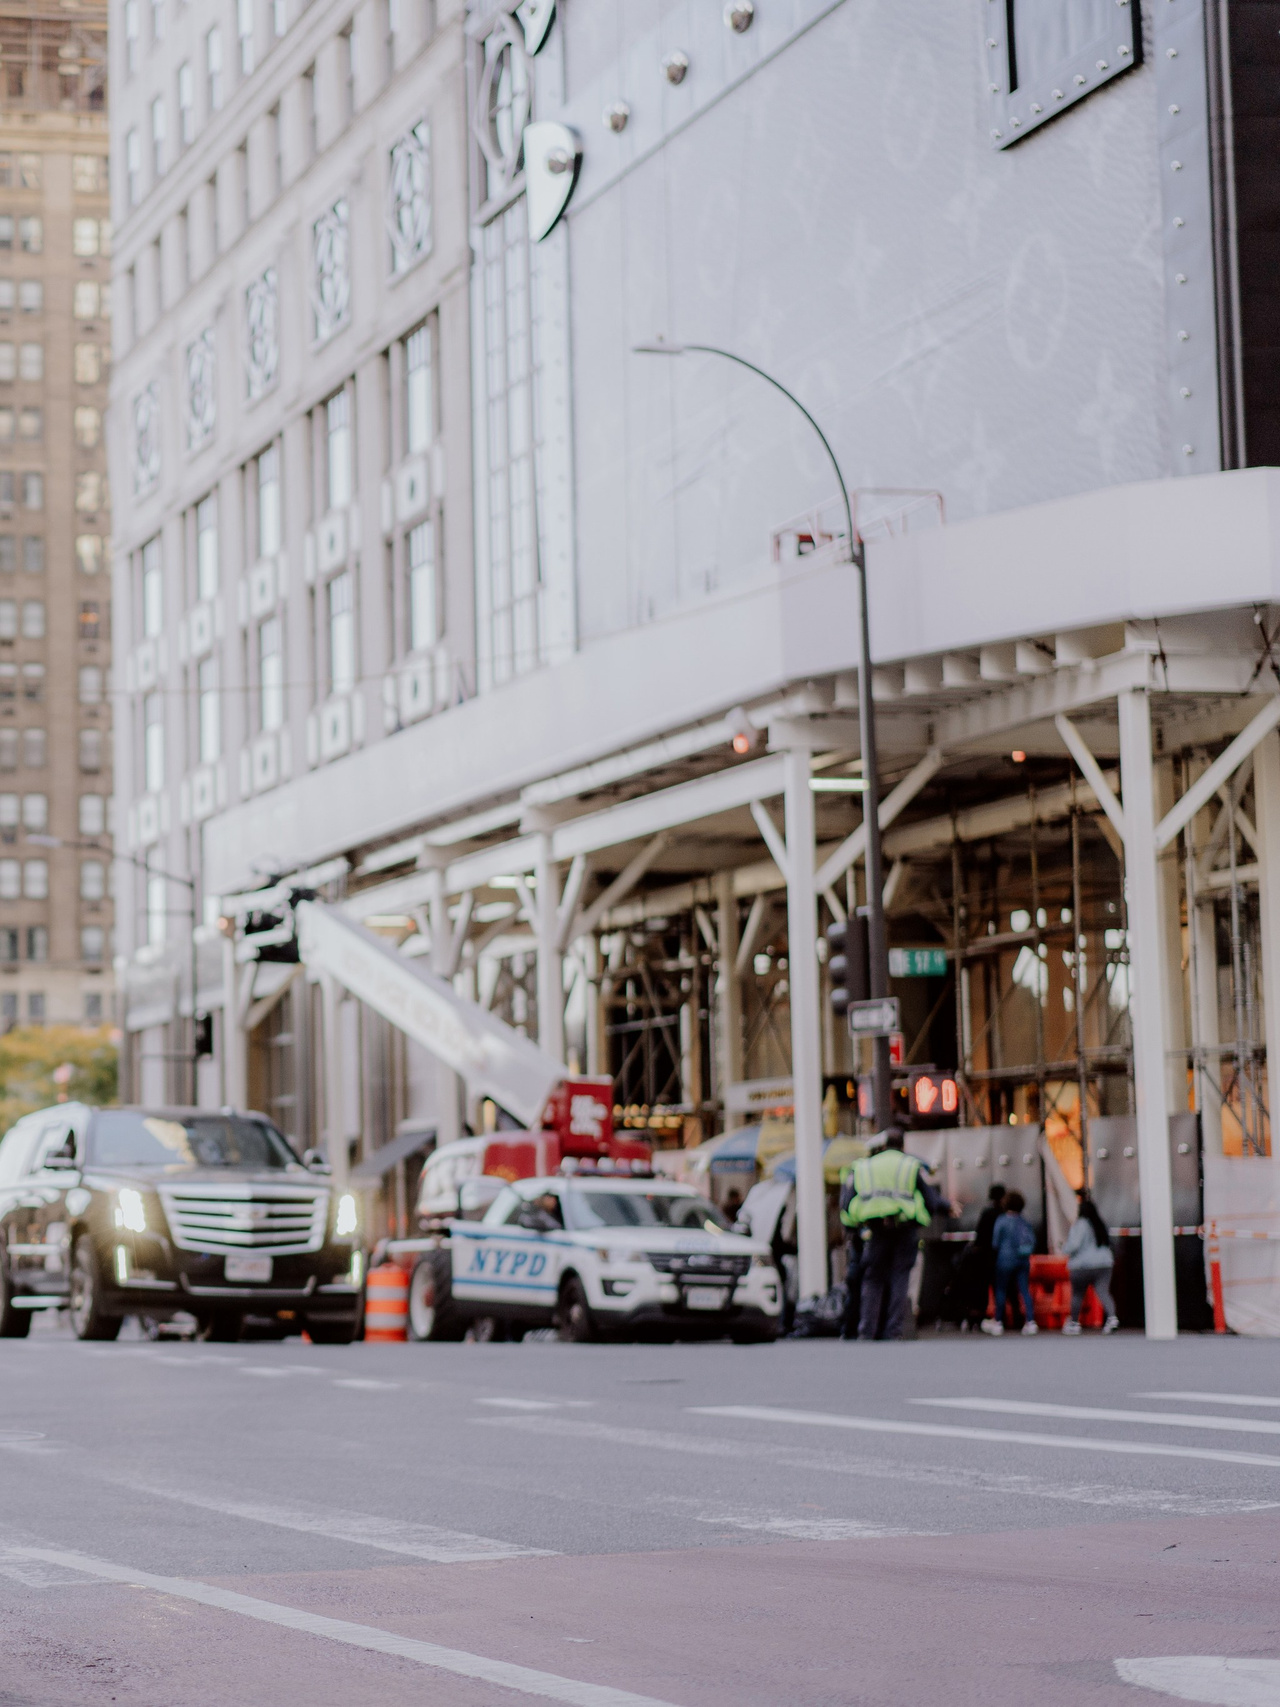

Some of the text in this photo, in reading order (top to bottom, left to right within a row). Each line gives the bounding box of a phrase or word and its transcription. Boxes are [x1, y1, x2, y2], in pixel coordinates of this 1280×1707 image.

[902, 950, 911, 975] E
[915, 950, 930, 975] 57
[941, 1079, 958, 1112] 0
[469, 1247, 548, 1277] NYPD
